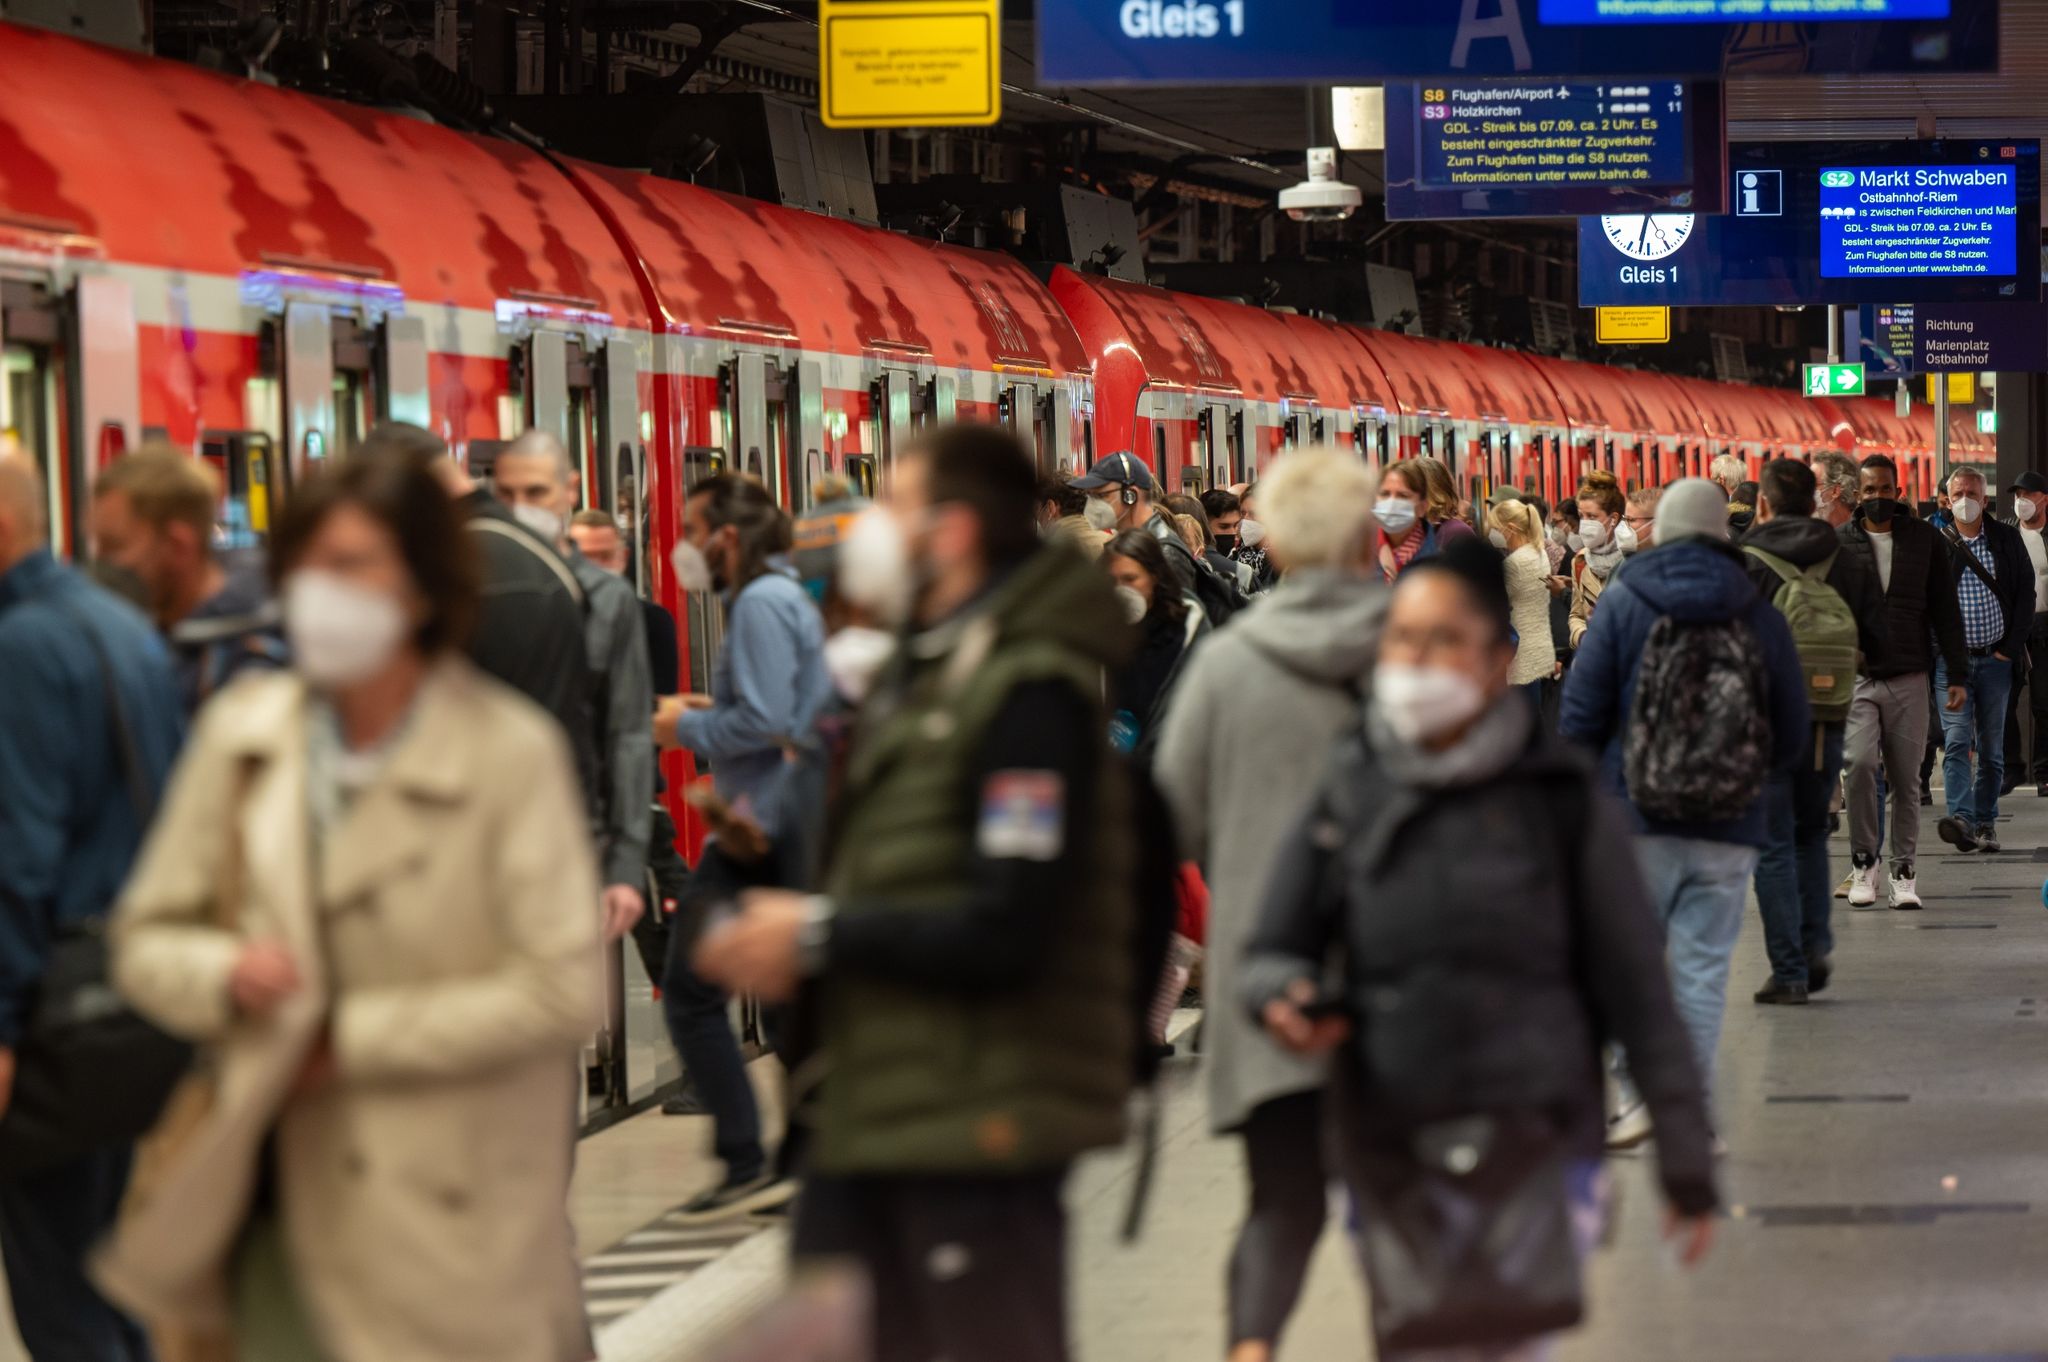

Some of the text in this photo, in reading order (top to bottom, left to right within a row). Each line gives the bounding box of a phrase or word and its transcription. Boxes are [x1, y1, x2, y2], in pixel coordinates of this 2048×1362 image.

[1120, 0, 1243, 38] Gleis 1
[1424, 85, 1682, 103] S8 Flughafen/Airport 1 3
[1425, 102, 1682, 118] S3 Holzkirchen 1 11
[1444, 123, 1470, 134] GDL
[1482, 121, 1515, 133] Streik
[1520, 121, 1536, 132] bis
[1540, 120, 1576, 131] 07.09.
[1580, 121, 1597, 131] ca.
[1602, 120, 1609, 130] 2
[1613, 119, 1638, 130] Uhr.
[1642, 119, 1657, 129] Es
[1442, 135, 1655, 151] besteht eingeschränkter Zugverkehr.
[1447, 153, 1651, 168] Zum Flughafen bitte die S8 nutzen.
[1452, 169, 1650, 183] Informationen unter www.bahn.de.
[1826, 170, 2007, 186] S2 Markt Schwaben
[1860, 192, 1958, 203] Ostbahnhof-Riem
[1870, 207, 1915, 217] zwischen
[1917, 206, 1972, 216] Feldkirchen
[1975, 206, 1993, 215] und
[1845, 224, 1863, 232] GDL
[1871, 224, 1894, 232] Streik
[1897, 223, 1909, 231] bis
[1911, 223, 1936, 231] 07.09.
[1954, 223, 1959, 231] 2
[1962, 223, 1978, 231] Uhr.
[1981, 222, 1992, 230] Es
[1842, 236, 1992, 247] besteht eingeschränkter Zugverkehr.
[1867, 251, 1907, 261] Flughafen
[1910, 251, 1927, 259] bitte
[1945, 250, 1956, 258] S8
[1958, 250, 1988, 258] nutzen.
[1620, 266, 1677, 283] Gleis 1
[1849, 265, 1905, 273] Informationen
[1931, 264, 1988, 272] www.bahn.de.
[1925, 320, 1973, 332] Richtung
[1925, 340, 1989, 352] Marienplatz
[1925, 353, 1988, 364] Ostbahnhof
